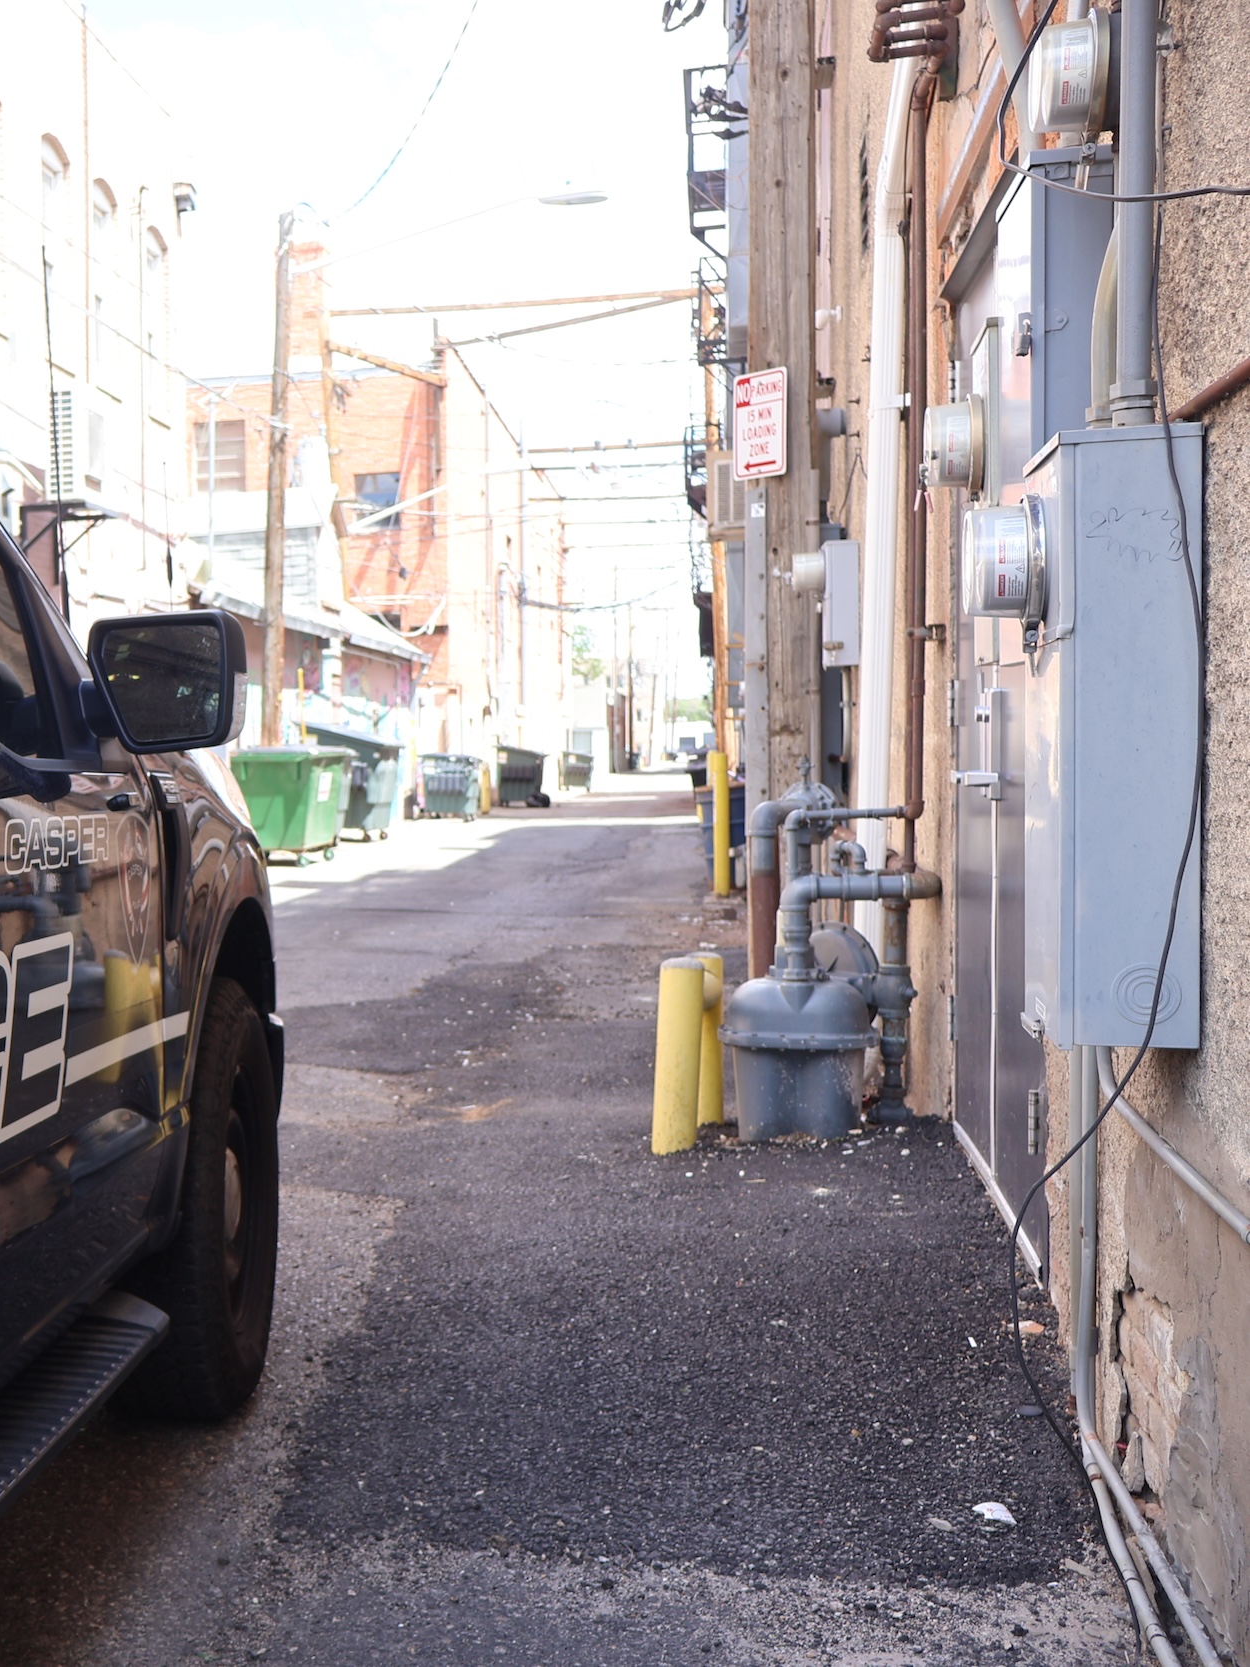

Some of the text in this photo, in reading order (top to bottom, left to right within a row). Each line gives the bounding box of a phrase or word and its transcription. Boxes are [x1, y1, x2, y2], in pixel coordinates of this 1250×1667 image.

[737, 380, 782, 404] NO PARKING
[748, 406, 772, 422] 15 MIN
[743, 424, 776, 441] LOADING
[750, 442, 770, 457] ZONE
[4, 813, 110, 875] CASPER
